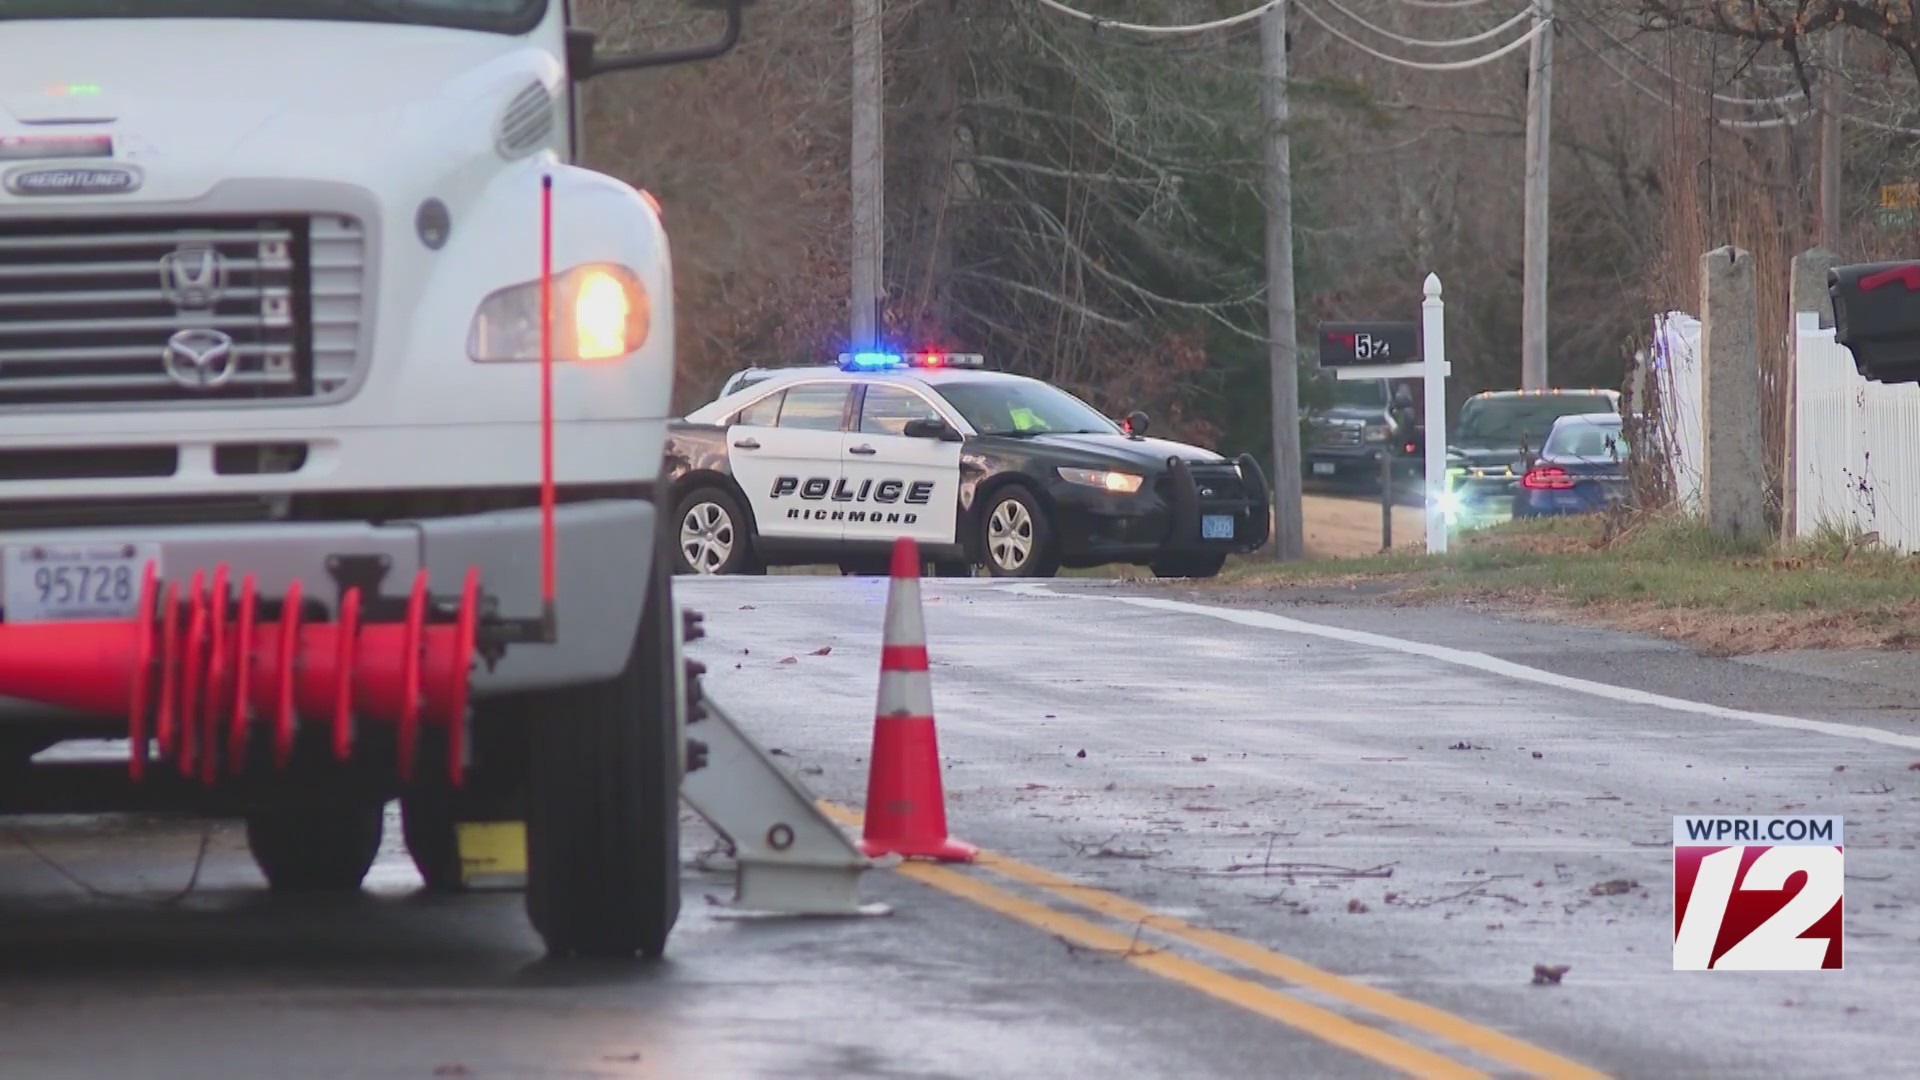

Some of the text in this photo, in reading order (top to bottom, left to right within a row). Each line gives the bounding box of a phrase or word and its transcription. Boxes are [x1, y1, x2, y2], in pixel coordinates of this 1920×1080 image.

[20, 171, 127, 187] FREIGHTLINER
[770, 477, 936, 504] POLICE
[787, 508, 918, 524] RICHMOND
[34, 564, 132, 602] 95728
